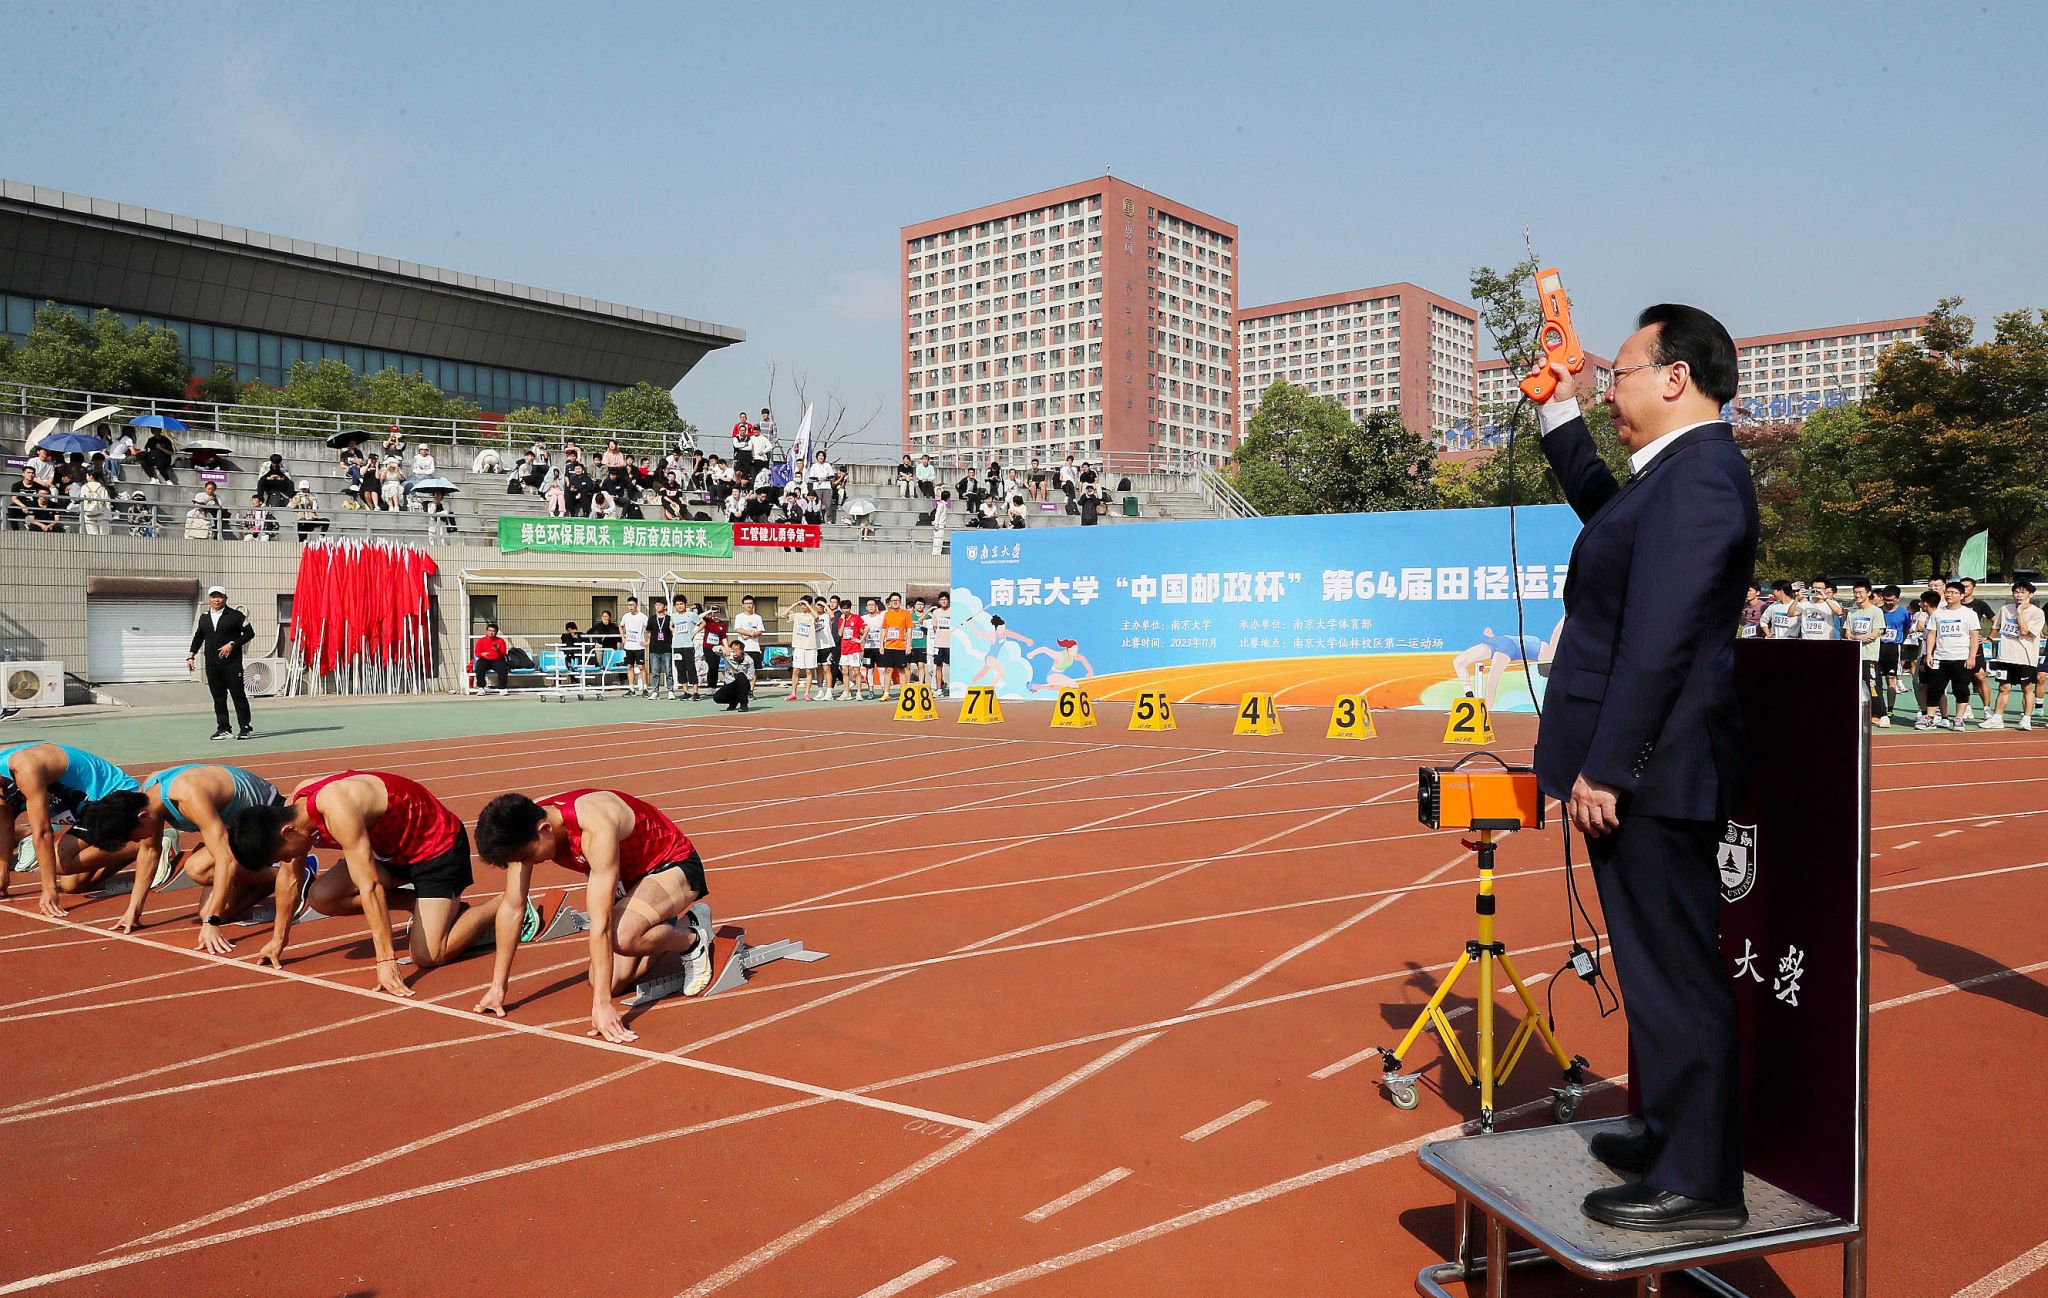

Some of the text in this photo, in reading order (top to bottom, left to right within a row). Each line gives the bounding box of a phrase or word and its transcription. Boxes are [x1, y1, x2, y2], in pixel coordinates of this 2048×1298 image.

[740, 527, 814, 542] 工管健儿勇争第一
[990, 575, 1099, 607] 南京大学
[1805, 622, 1822, 630] 1296
[1940, 625, 1960, 633] 0244
